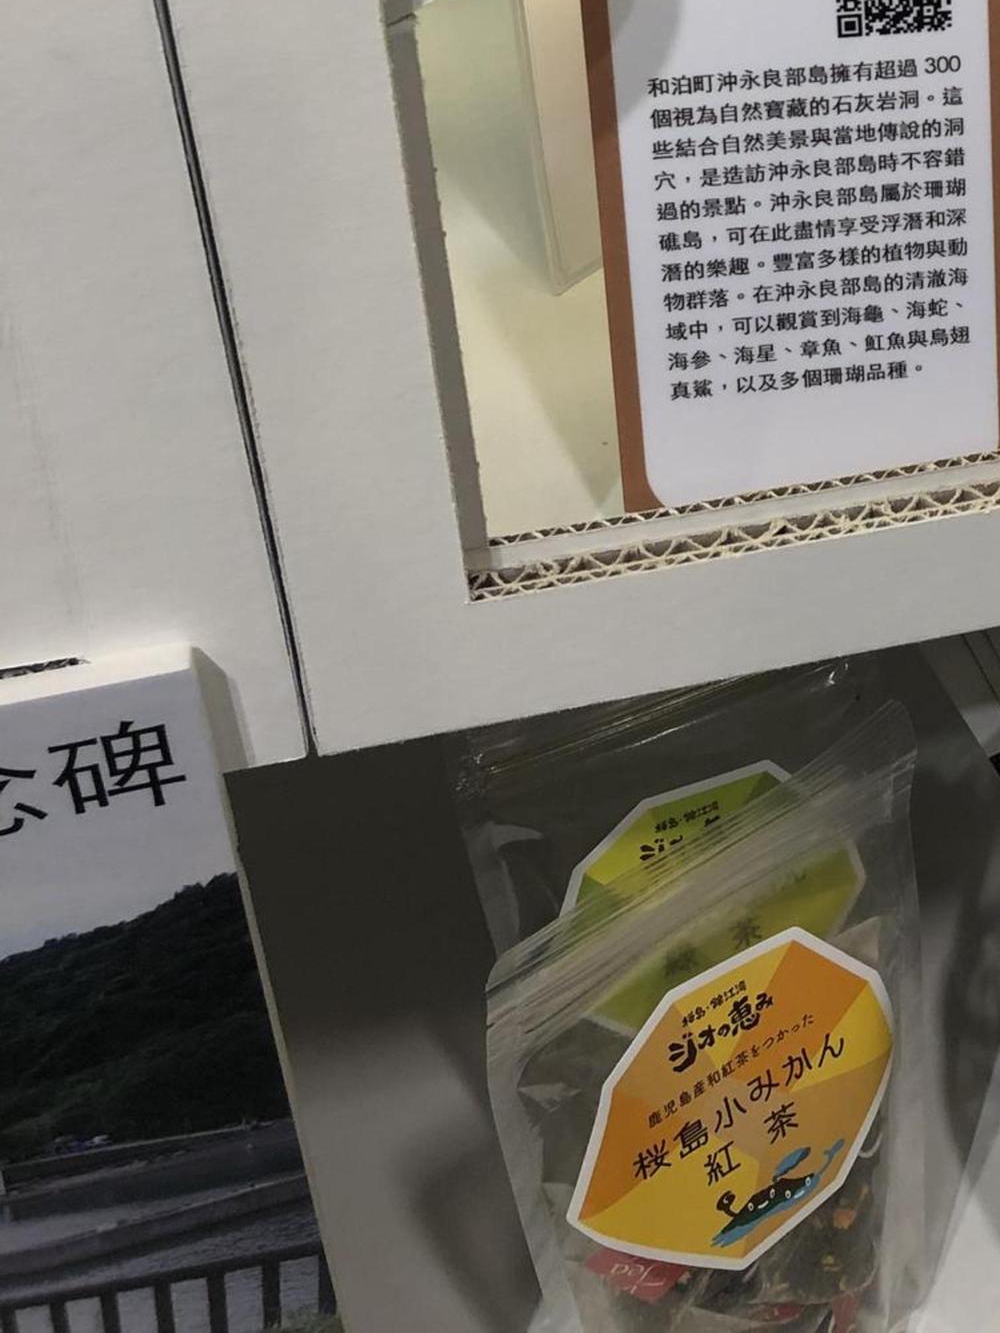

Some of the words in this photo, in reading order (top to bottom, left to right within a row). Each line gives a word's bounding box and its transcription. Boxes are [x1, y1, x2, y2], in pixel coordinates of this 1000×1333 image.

[648, 59, 918, 99] 和泊町沖永良部島擁有超過
[924, 54, 961, 76] 300
[650, 87, 963, 130] 個視為自然寶藏的石灰岩洞。這
[652, 117, 965, 161] 些結合自然美景與當地傳說的洞
[654, 147, 966, 191] 穴，是造訪沖永良部島時不容錯
[657, 178, 966, 222] 過的景點。沖永良部島屬於珊瑚
[659, 208, 967, 252] 礁島，可在此盡情享受浮潛和深
[661, 237, 968, 283] 潛的樂趣。豐富多樣的植物與動
[663, 268, 968, 312] 物群落。在沖永良部島的清澈海
[666, 298, 965, 342] 域中，可以觀賞到海龜、海蛇、
[669, 359, 925, 401] 真鯊，以及多個珊瑚品種。
[667, 990, 775, 1073] ジオの恵み
[647, 1011, 816, 1129] 鹿児島産和紅茶をつかった
[632, 1031, 847, 1180] 桜島小みかん
